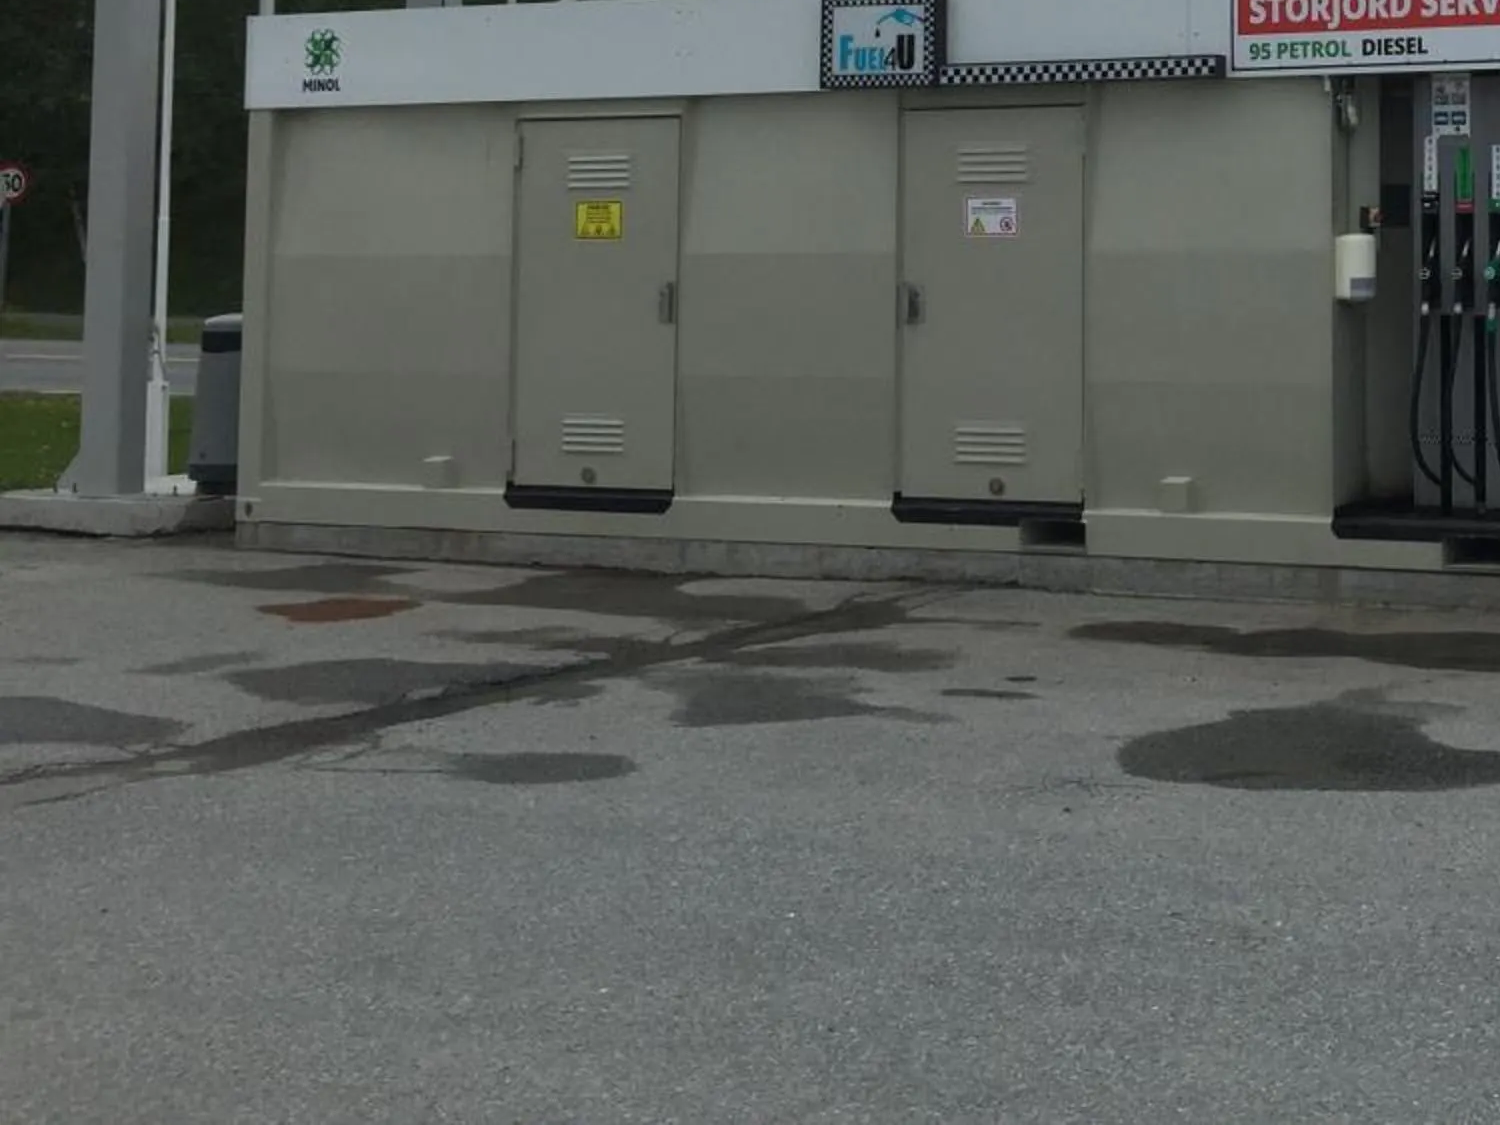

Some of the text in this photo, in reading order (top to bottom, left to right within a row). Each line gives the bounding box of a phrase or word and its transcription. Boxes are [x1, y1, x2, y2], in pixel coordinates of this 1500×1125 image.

[1249, 36, 1429, 60] 95 PETROL DIESEL
[302, 78, 342, 92] MINOL
